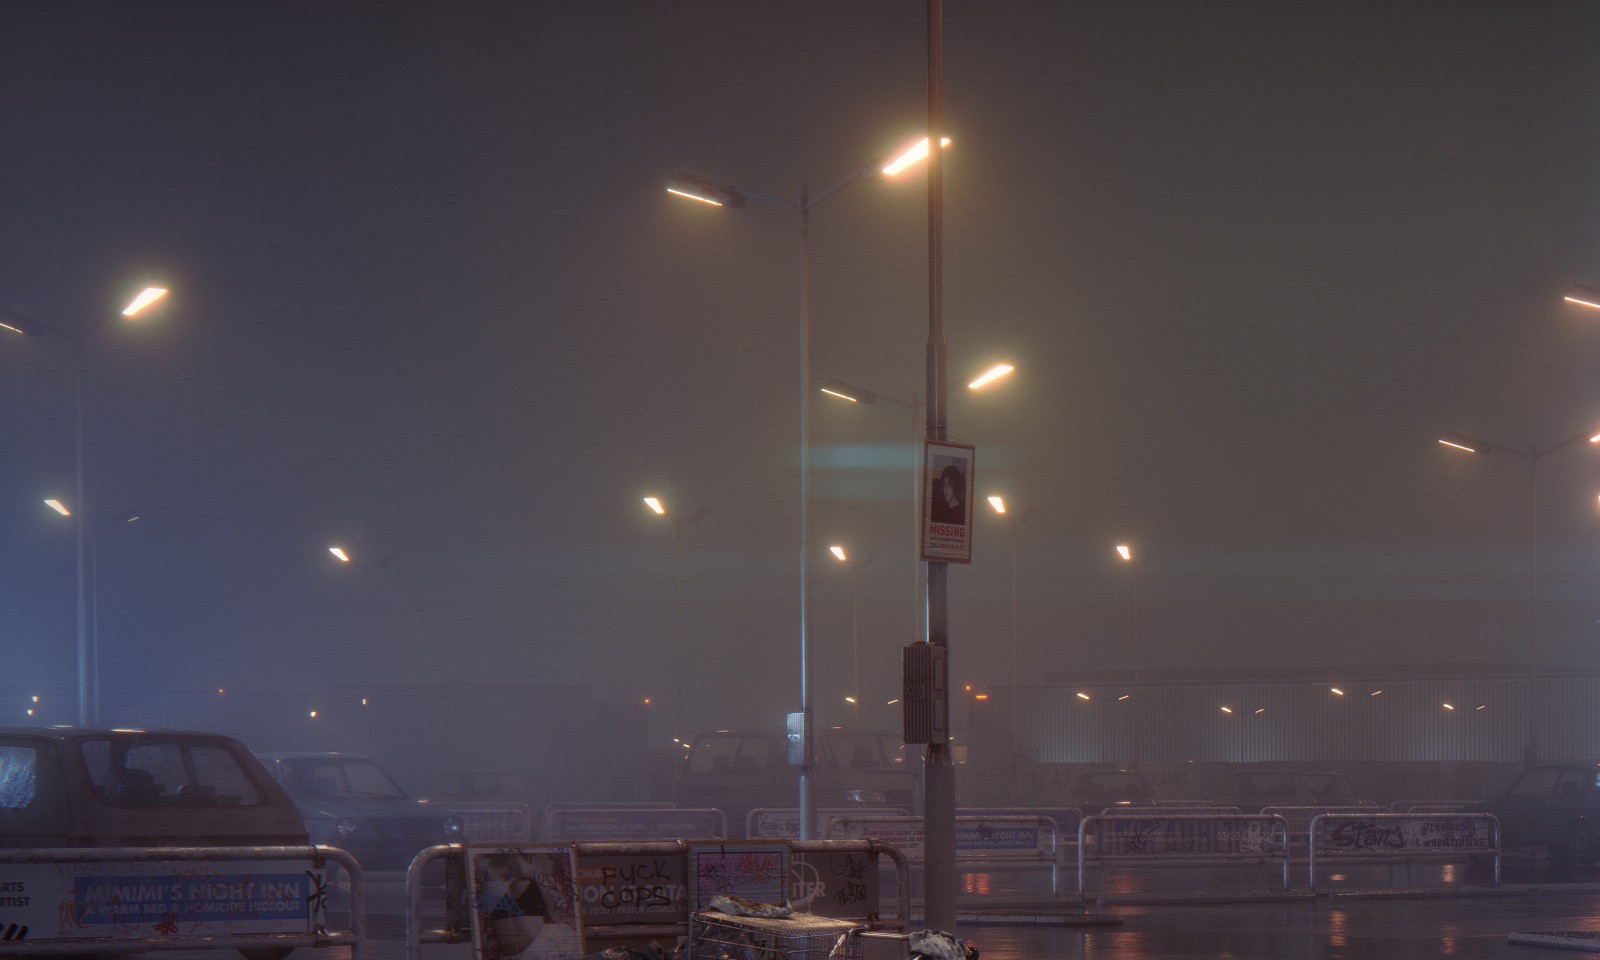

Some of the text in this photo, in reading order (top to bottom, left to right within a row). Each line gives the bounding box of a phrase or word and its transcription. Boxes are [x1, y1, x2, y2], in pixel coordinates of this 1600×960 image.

[930, 525, 965, 538] MISSING
[0, 882, 25, 893] RTS
[190, 881, 257, 901] NIGHT
[261, 880, 301, 900] INN
[601, 886, 670, 908] COPS
[98, 903, 140, 915] WARM
[145, 902, 168, 913] BED
[184, 900, 246, 912] HOMICIDE
[249, 899, 300, 912] HIDEOUT
